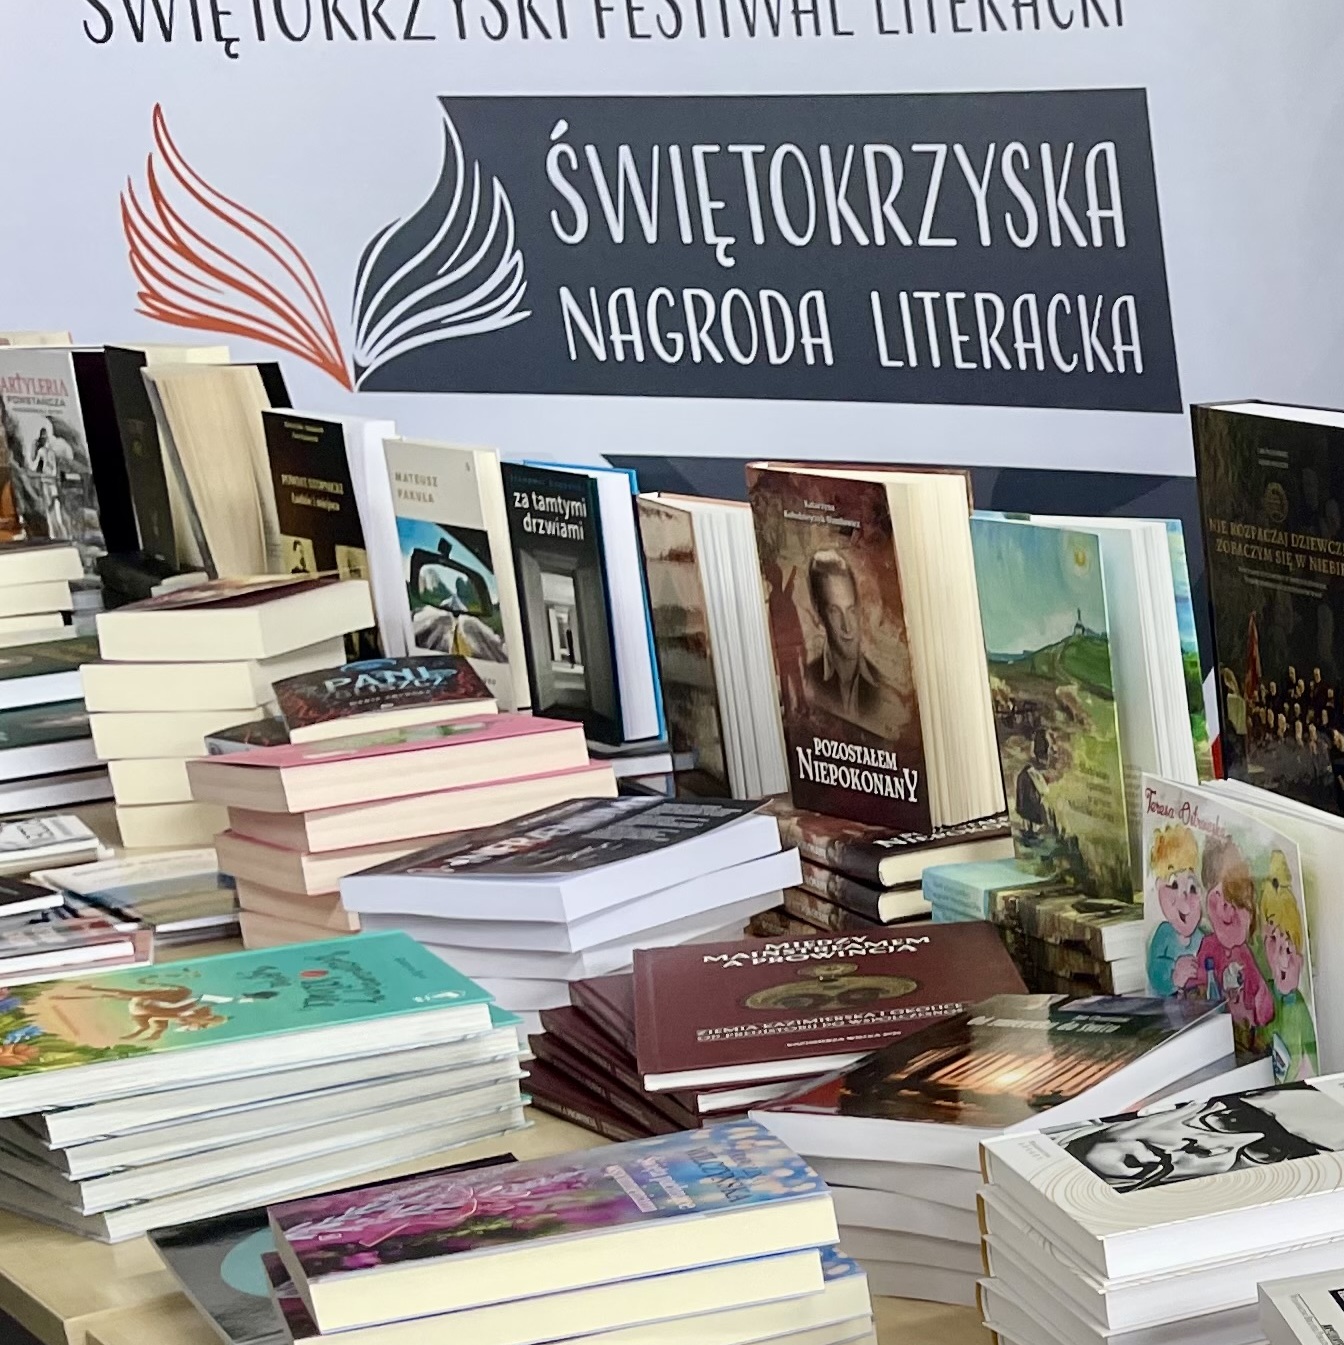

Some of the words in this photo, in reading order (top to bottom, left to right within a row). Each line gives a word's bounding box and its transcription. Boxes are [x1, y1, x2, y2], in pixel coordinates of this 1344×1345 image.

[546, 118, 1127, 267] ŚWIĘTOKRZYSKA
[558, 285, 833, 368] NAGRODA
[871, 289, 1144, 376] LITERACKA
[513, 491, 530, 509] za
[531, 490, 588, 520] tamtymi
[522, 511, 585, 541] drzwiami
[1295, 552, 1308, 569] W
[813, 736, 898, 772] POZOSTAŁEM
[796, 745, 919, 803] NIEPOKONANY
[1144, 787, 1175, 819] Teresa
